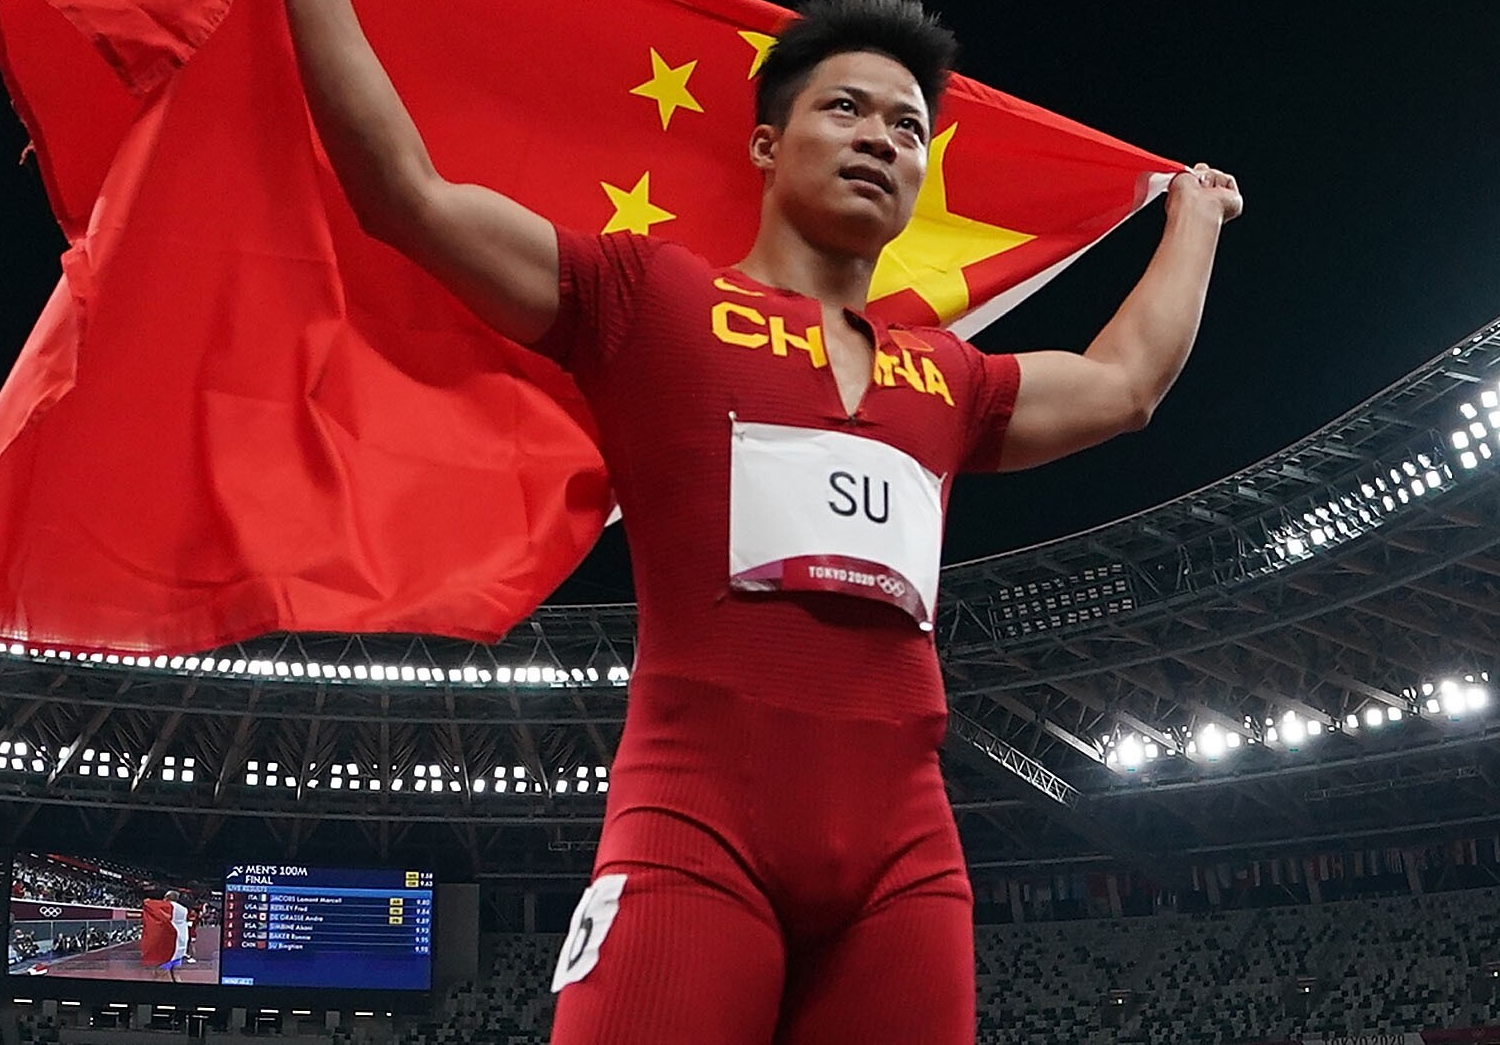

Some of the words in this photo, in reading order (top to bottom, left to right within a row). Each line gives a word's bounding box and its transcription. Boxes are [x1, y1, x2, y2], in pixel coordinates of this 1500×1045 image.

[829, 471, 889, 524] SU
[808, 566, 847, 581] TOKYO
[847, 571, 875, 586] 2020
[245, 865, 277, 875] MEN'S
[279, 866, 308, 876] 100M
[245, 875, 273, 885] FINAL
